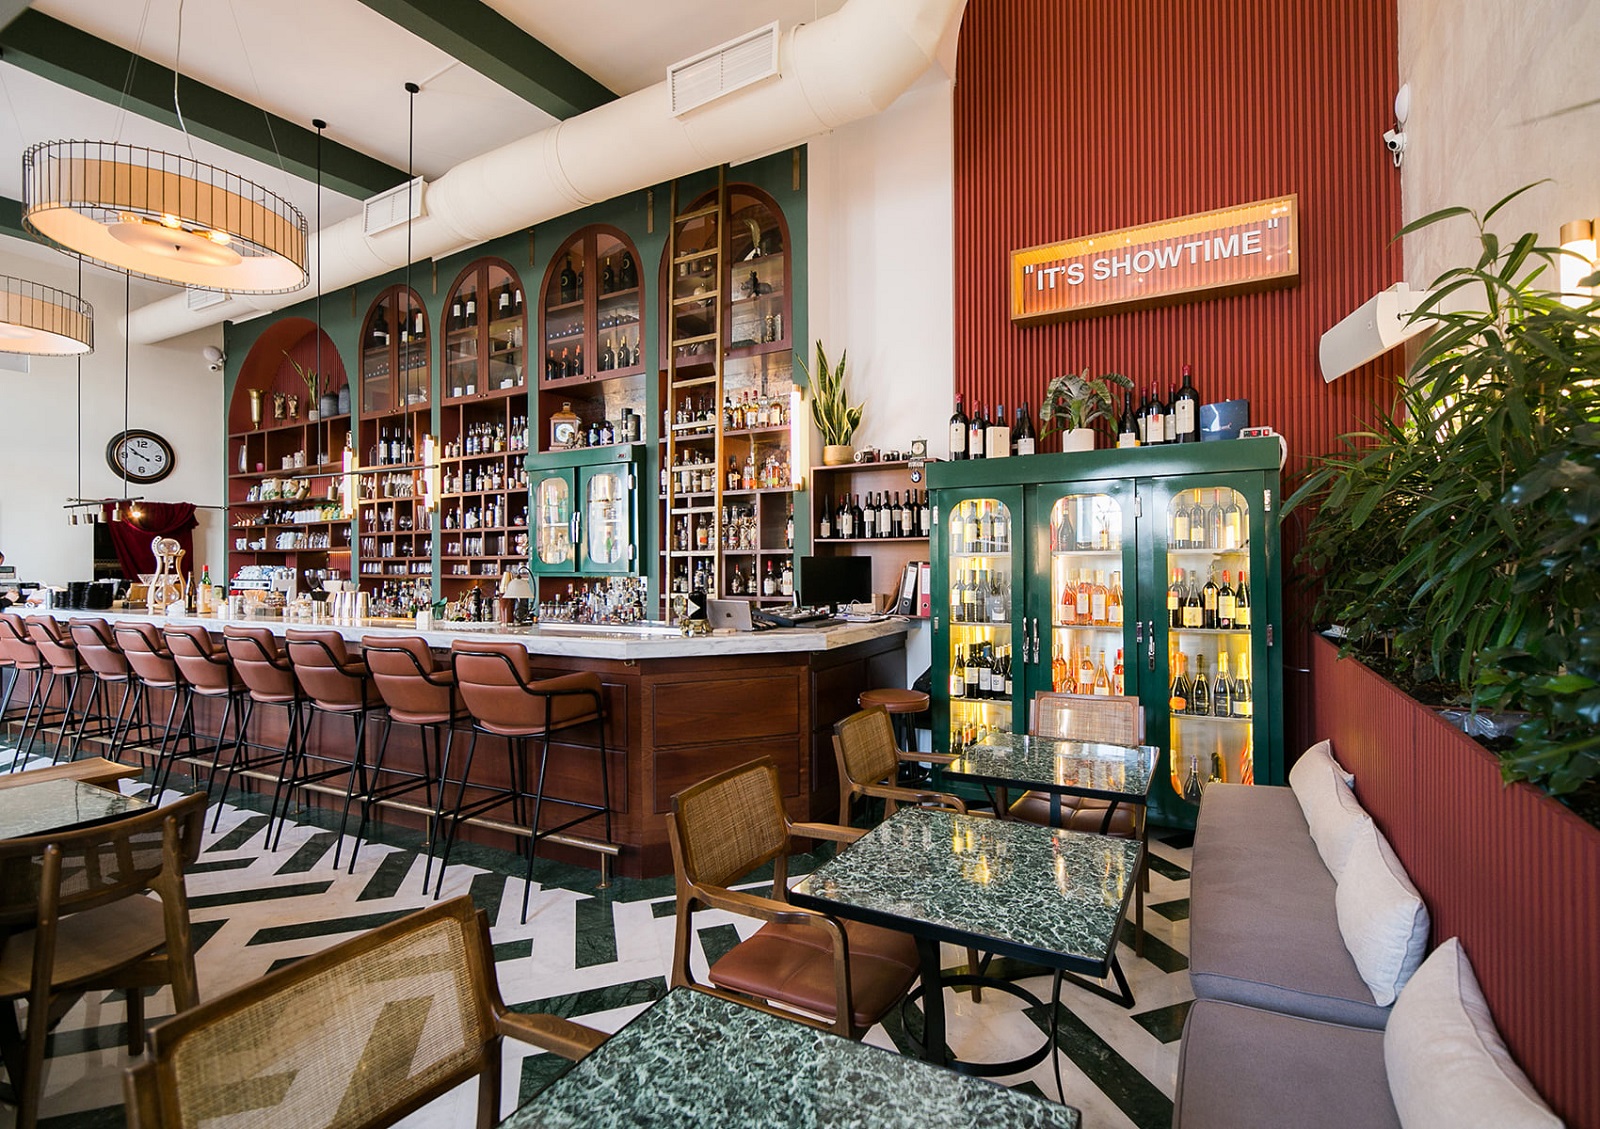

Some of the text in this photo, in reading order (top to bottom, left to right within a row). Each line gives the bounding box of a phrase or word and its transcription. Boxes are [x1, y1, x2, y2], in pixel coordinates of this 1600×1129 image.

[137, 440, 148, 448] 12
[154, 454, 163, 463] 3
[138, 466, 146, 474] 6
